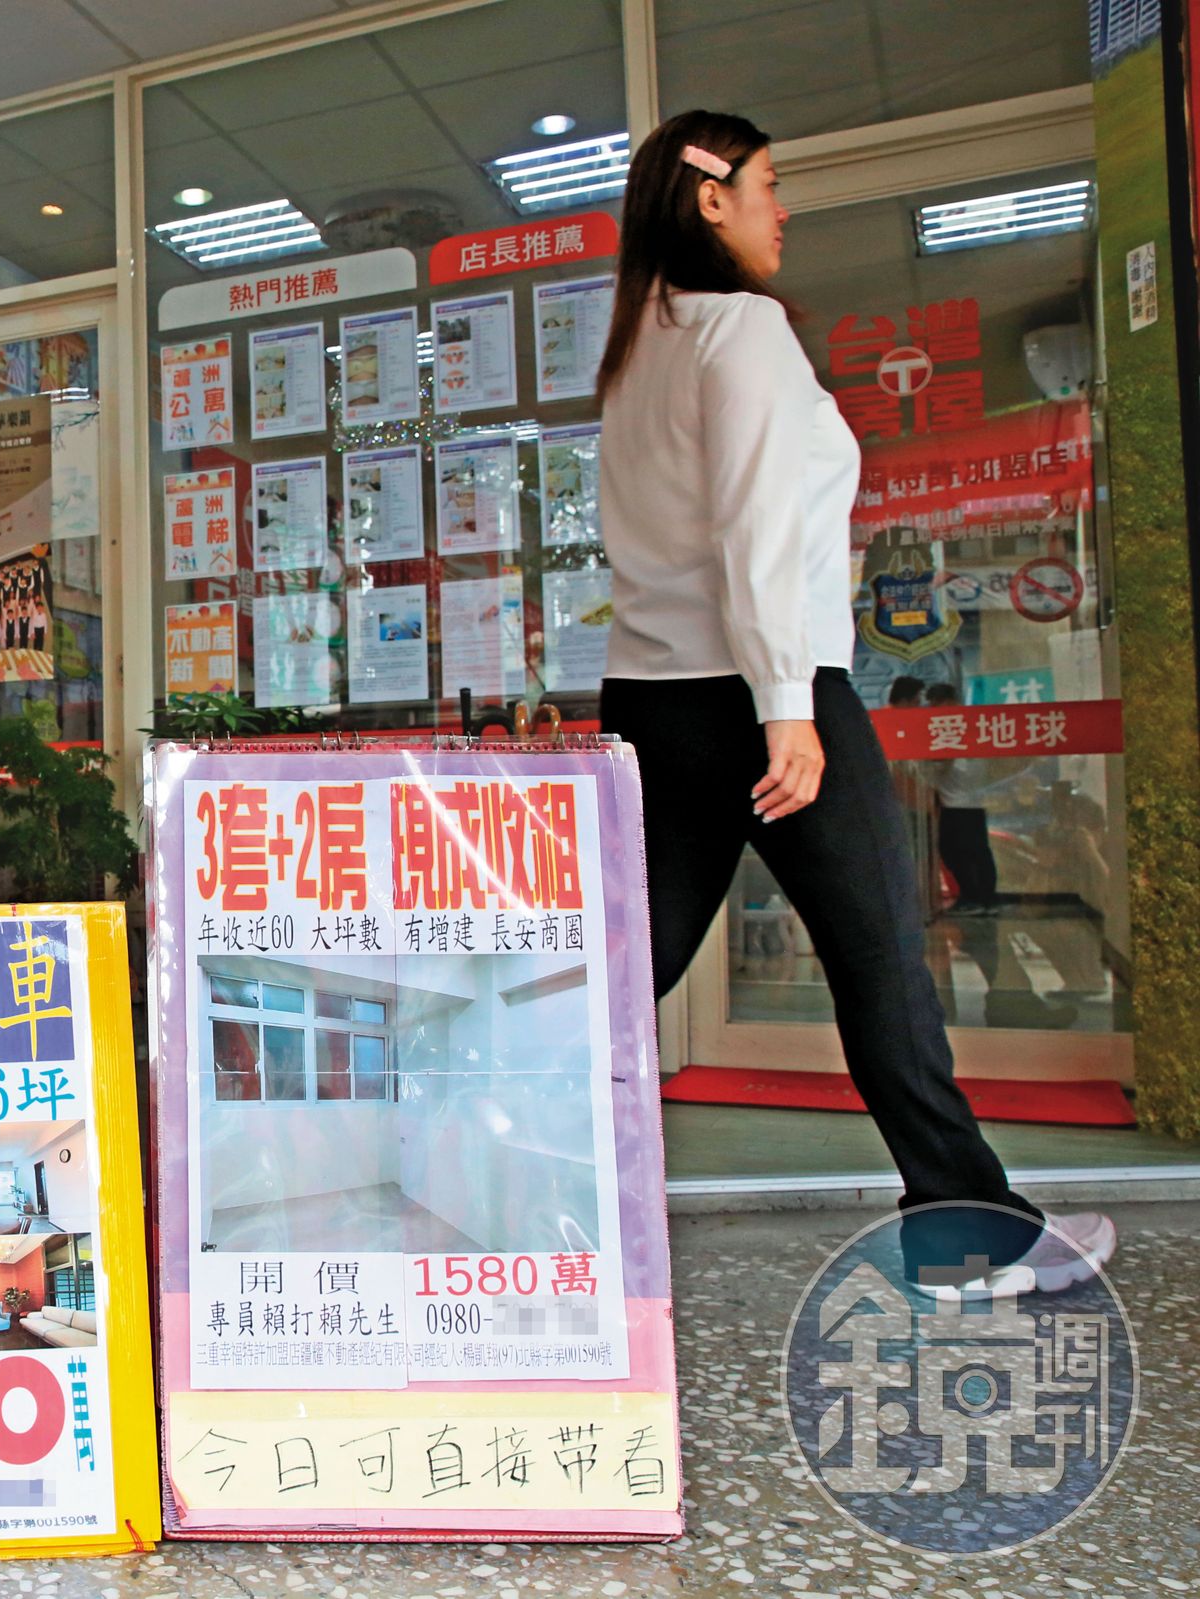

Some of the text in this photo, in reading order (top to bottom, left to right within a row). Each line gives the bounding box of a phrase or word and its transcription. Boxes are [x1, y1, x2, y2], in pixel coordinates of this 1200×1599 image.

[459, 224, 585, 273] 店長推薦
[229, 268, 339, 311] 熱門推薦
[173, 363, 220, 388] 蘆洲
[169, 388, 226, 419] 公寓
[175, 495, 224, 518] 蘆洲
[172, 519, 230, 548] 電梯
[169, 625, 233, 654] 不動產
[927, 711, 1068, 752] 愛地球
[197, 782, 584, 912] 3套+2房 現成收租
[198, 913, 584, 953] 年收近60 大坪數 有增建 長安商圈
[206, 1300, 400, 1338] 專員賴打賴先生
[177, 1422, 665, 1500] 今日可直接帶看
